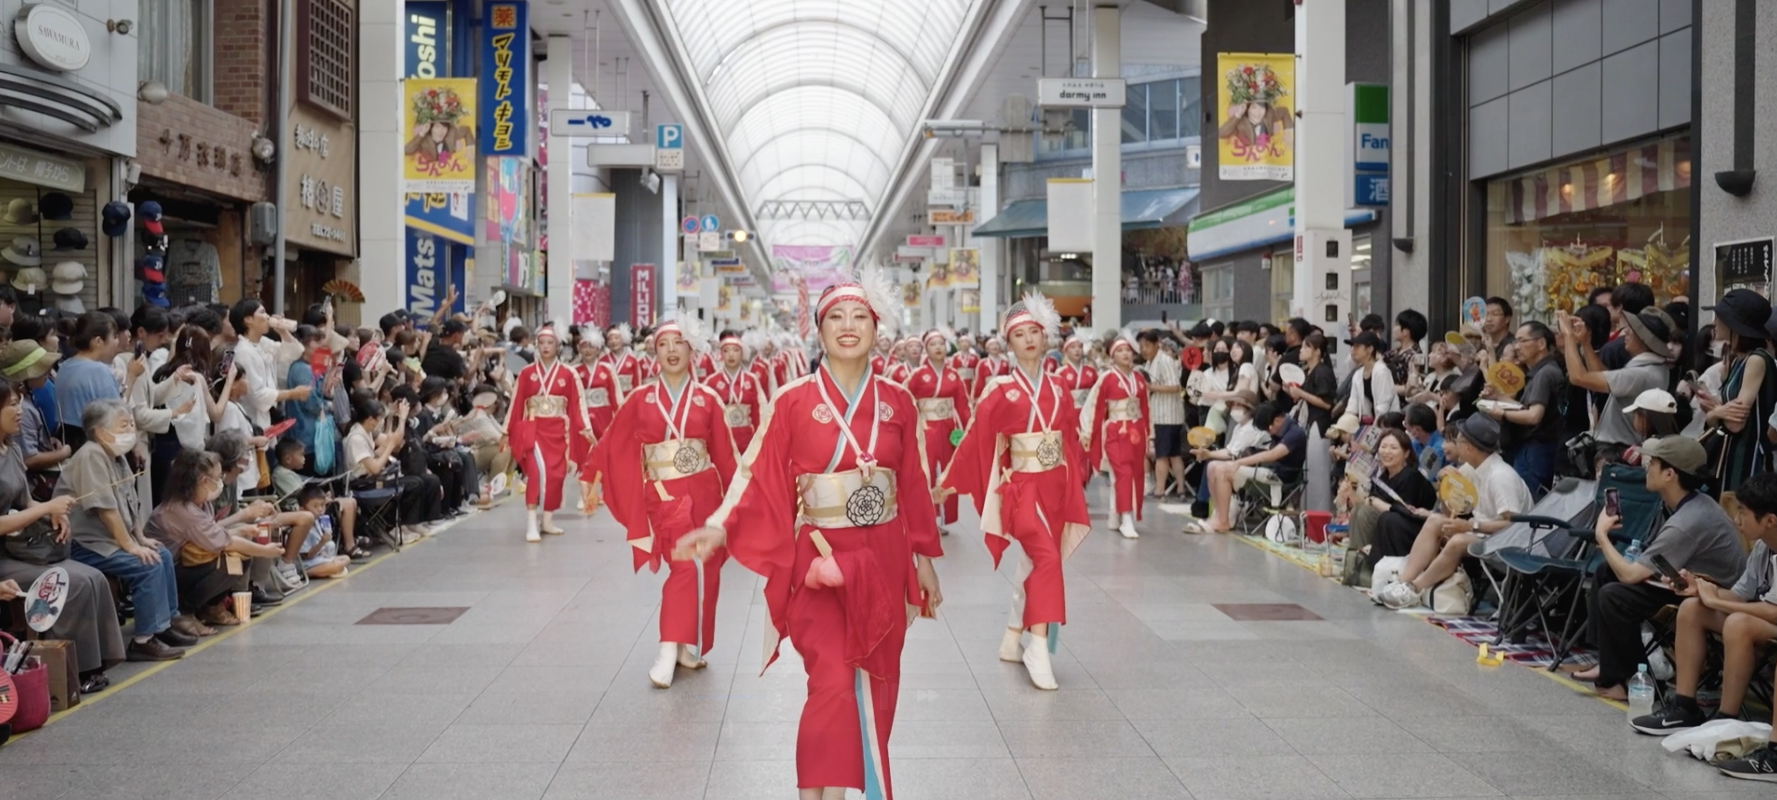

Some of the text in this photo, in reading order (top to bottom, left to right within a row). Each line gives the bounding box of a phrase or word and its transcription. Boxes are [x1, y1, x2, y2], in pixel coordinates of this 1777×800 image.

[37, 25, 80, 51] SAWAMURA
[410, 14, 436, 79] oshi
[492, 32, 515, 151] マツモトキヨシ
[1093, 91, 1107, 99] inn
[663, 125, 679, 147] P
[636, 269, 650, 327] MILLION
